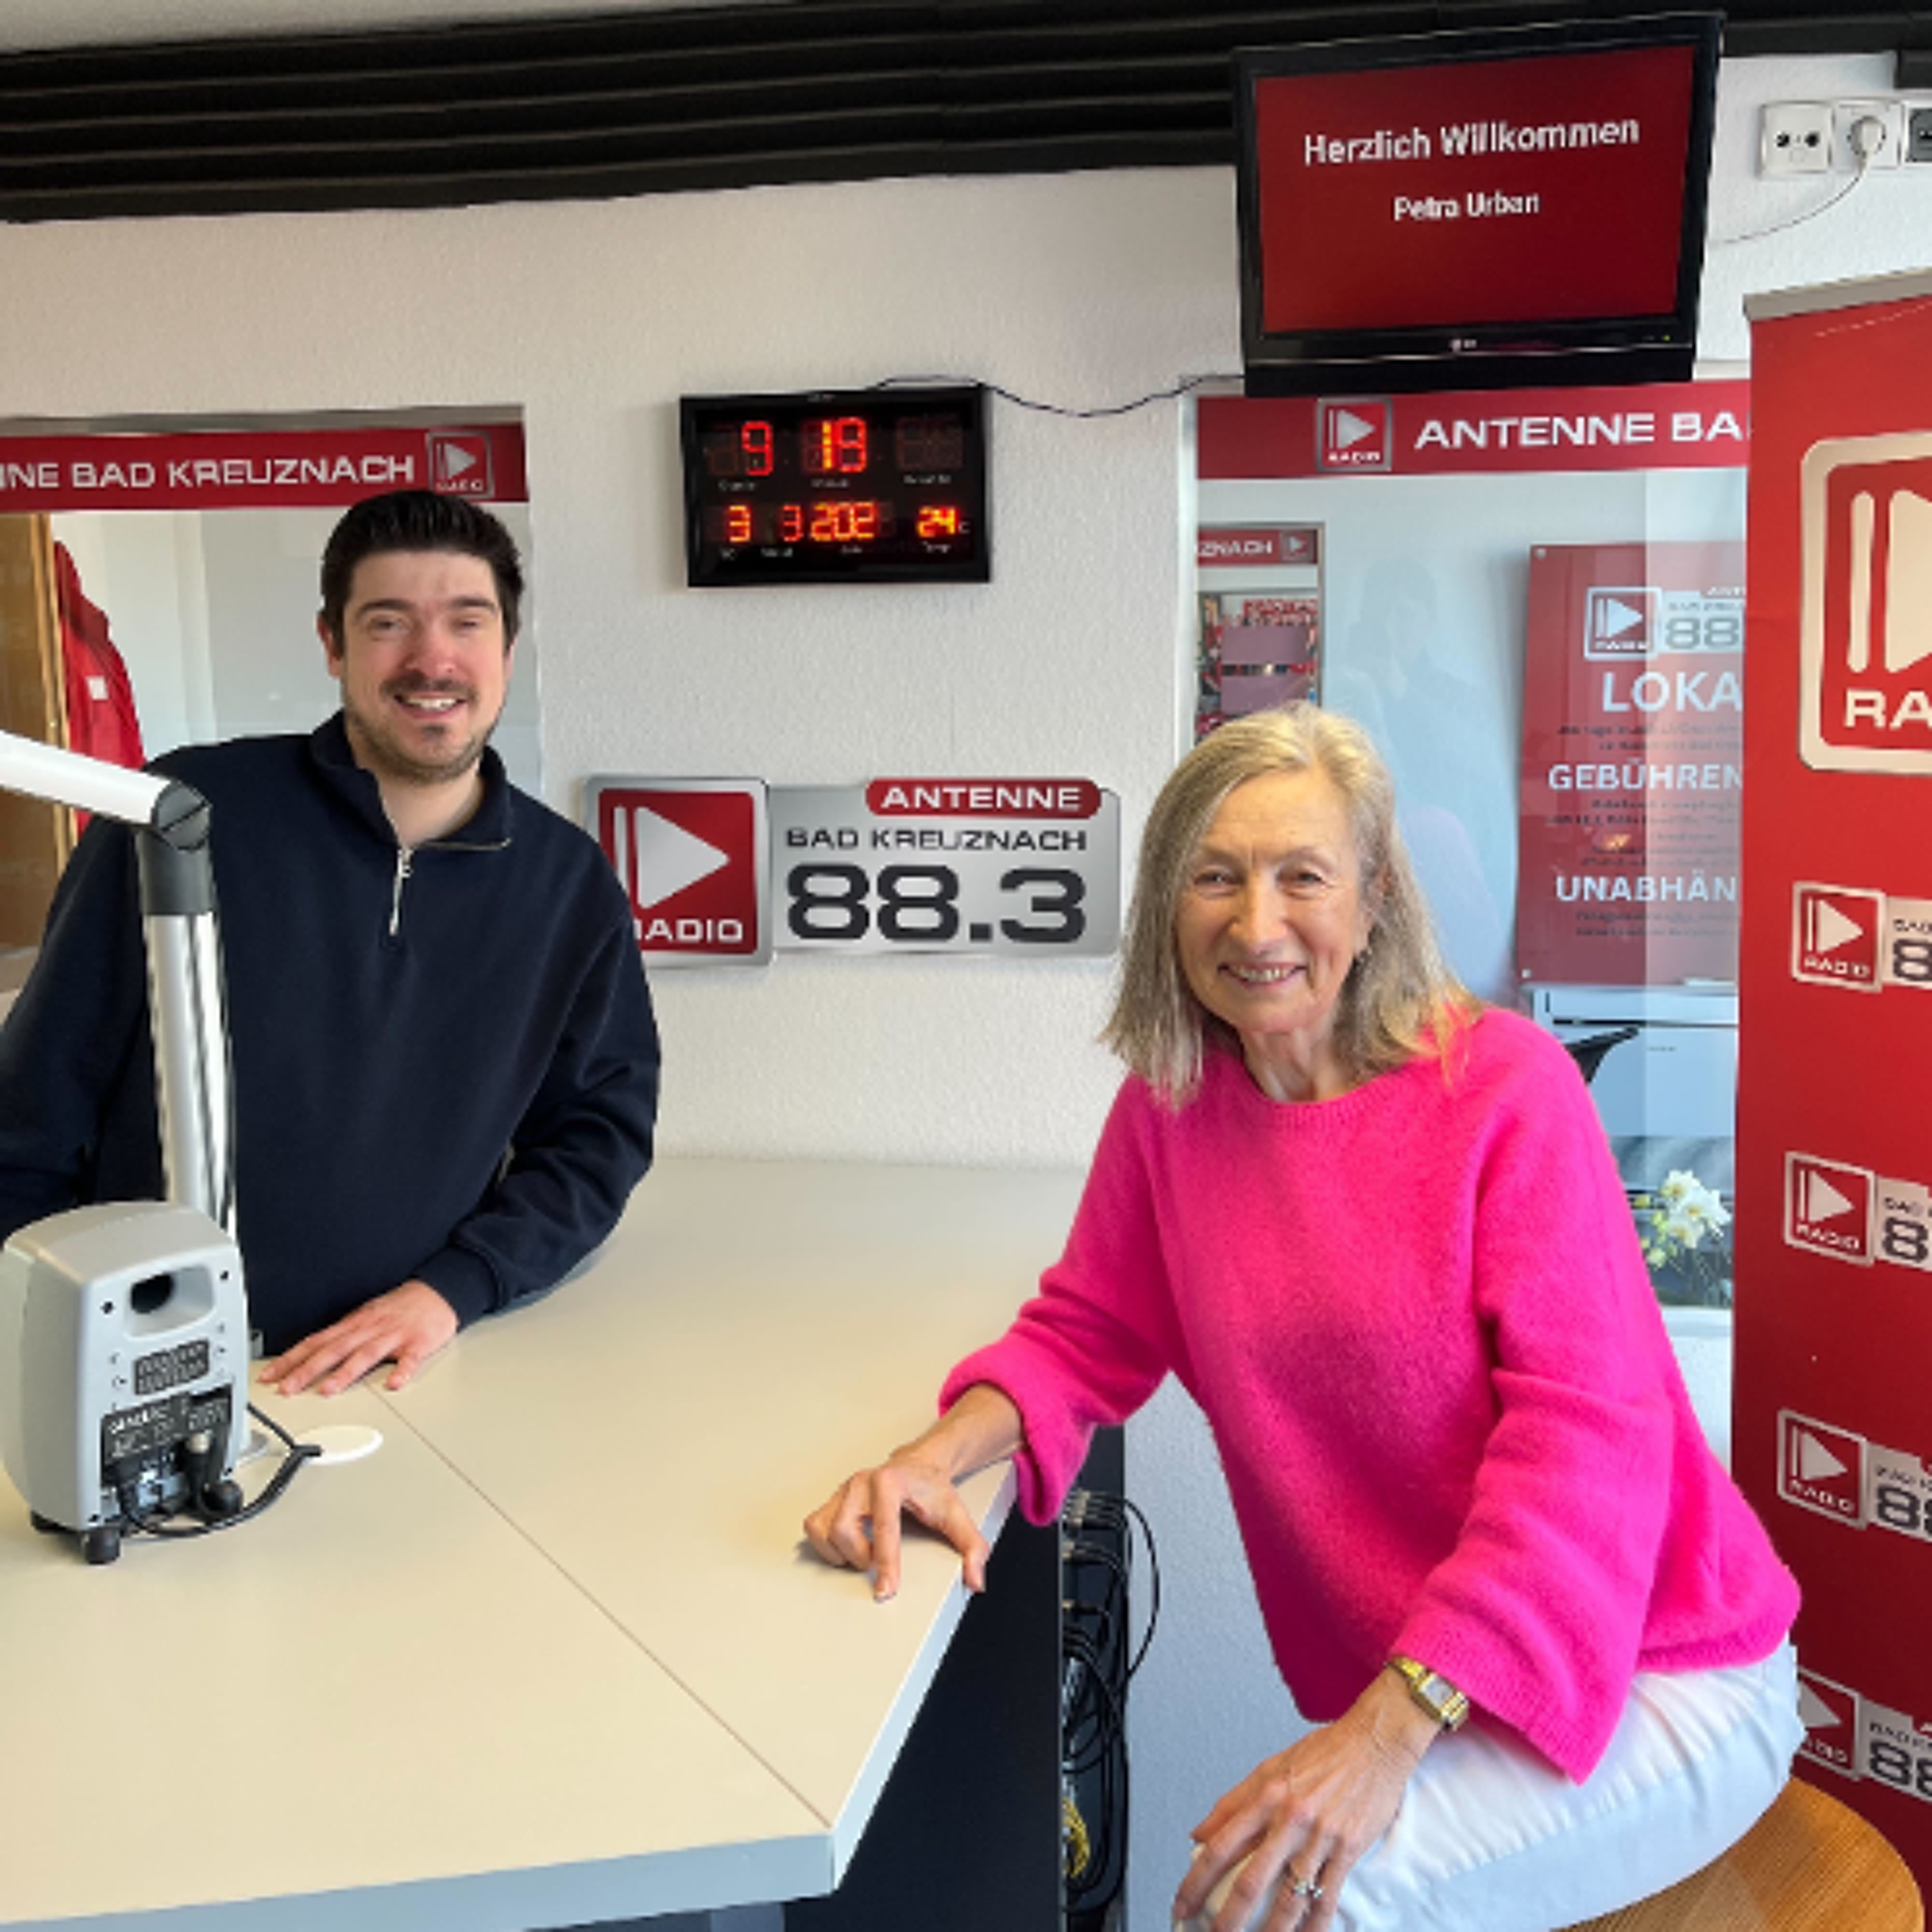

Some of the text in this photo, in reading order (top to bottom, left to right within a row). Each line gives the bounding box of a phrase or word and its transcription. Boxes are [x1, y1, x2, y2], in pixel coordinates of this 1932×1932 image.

[1304, 118, 1640, 166] Herzlich Willkommen
[1394, 191, 1540, 222] Petra Urban
[1414, 410, 1750, 450] ANTENNE BA
[741, 421, 773, 476] 9
[72, 462, 156, 488] BAD
[167, 454, 414, 488] KREUZNACH
[728, 504, 751, 542] 3
[782, 504, 802, 542] 3
[1602, 671, 1743, 712] LOKA
[1548, 757, 1743, 790] GEBÜHREN
[880, 786, 1081, 810] ANTENNE
[786, 828, 1086, 851] BAD KREUZNACH
[786, 864, 1086, 943] 88.3
[1556, 869, 1737, 902] UNABHÄN
